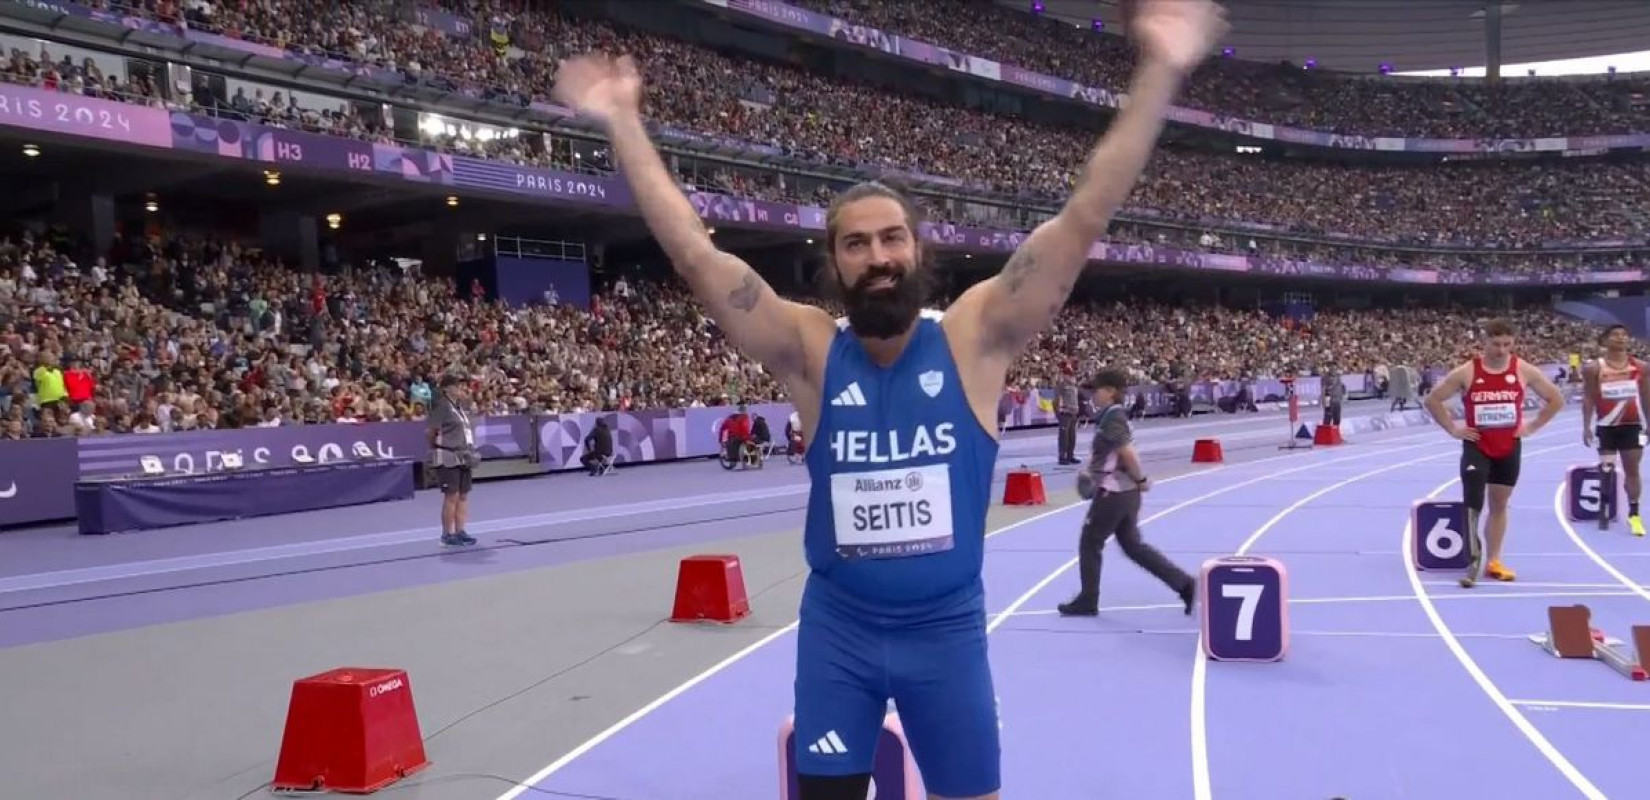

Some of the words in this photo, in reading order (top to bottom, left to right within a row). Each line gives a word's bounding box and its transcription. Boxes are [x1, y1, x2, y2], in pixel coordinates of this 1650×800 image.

[55, 104, 131, 132] 2024
[277, 141, 302, 161] H3
[348, 152, 372, 171] H2
[517, 173, 562, 193] PARIS
[567, 180, 606, 199] 2024
[830, 421, 956, 462] HELLAS
[855, 478, 902, 493] Allianz
[1578, 479, 1601, 512] 5
[852, 499, 932, 532] SEITIS
[1426, 518, 1463, 559] 6
[1222, 584, 1265, 640] 7
[377, 678, 403, 695] OMEGA
